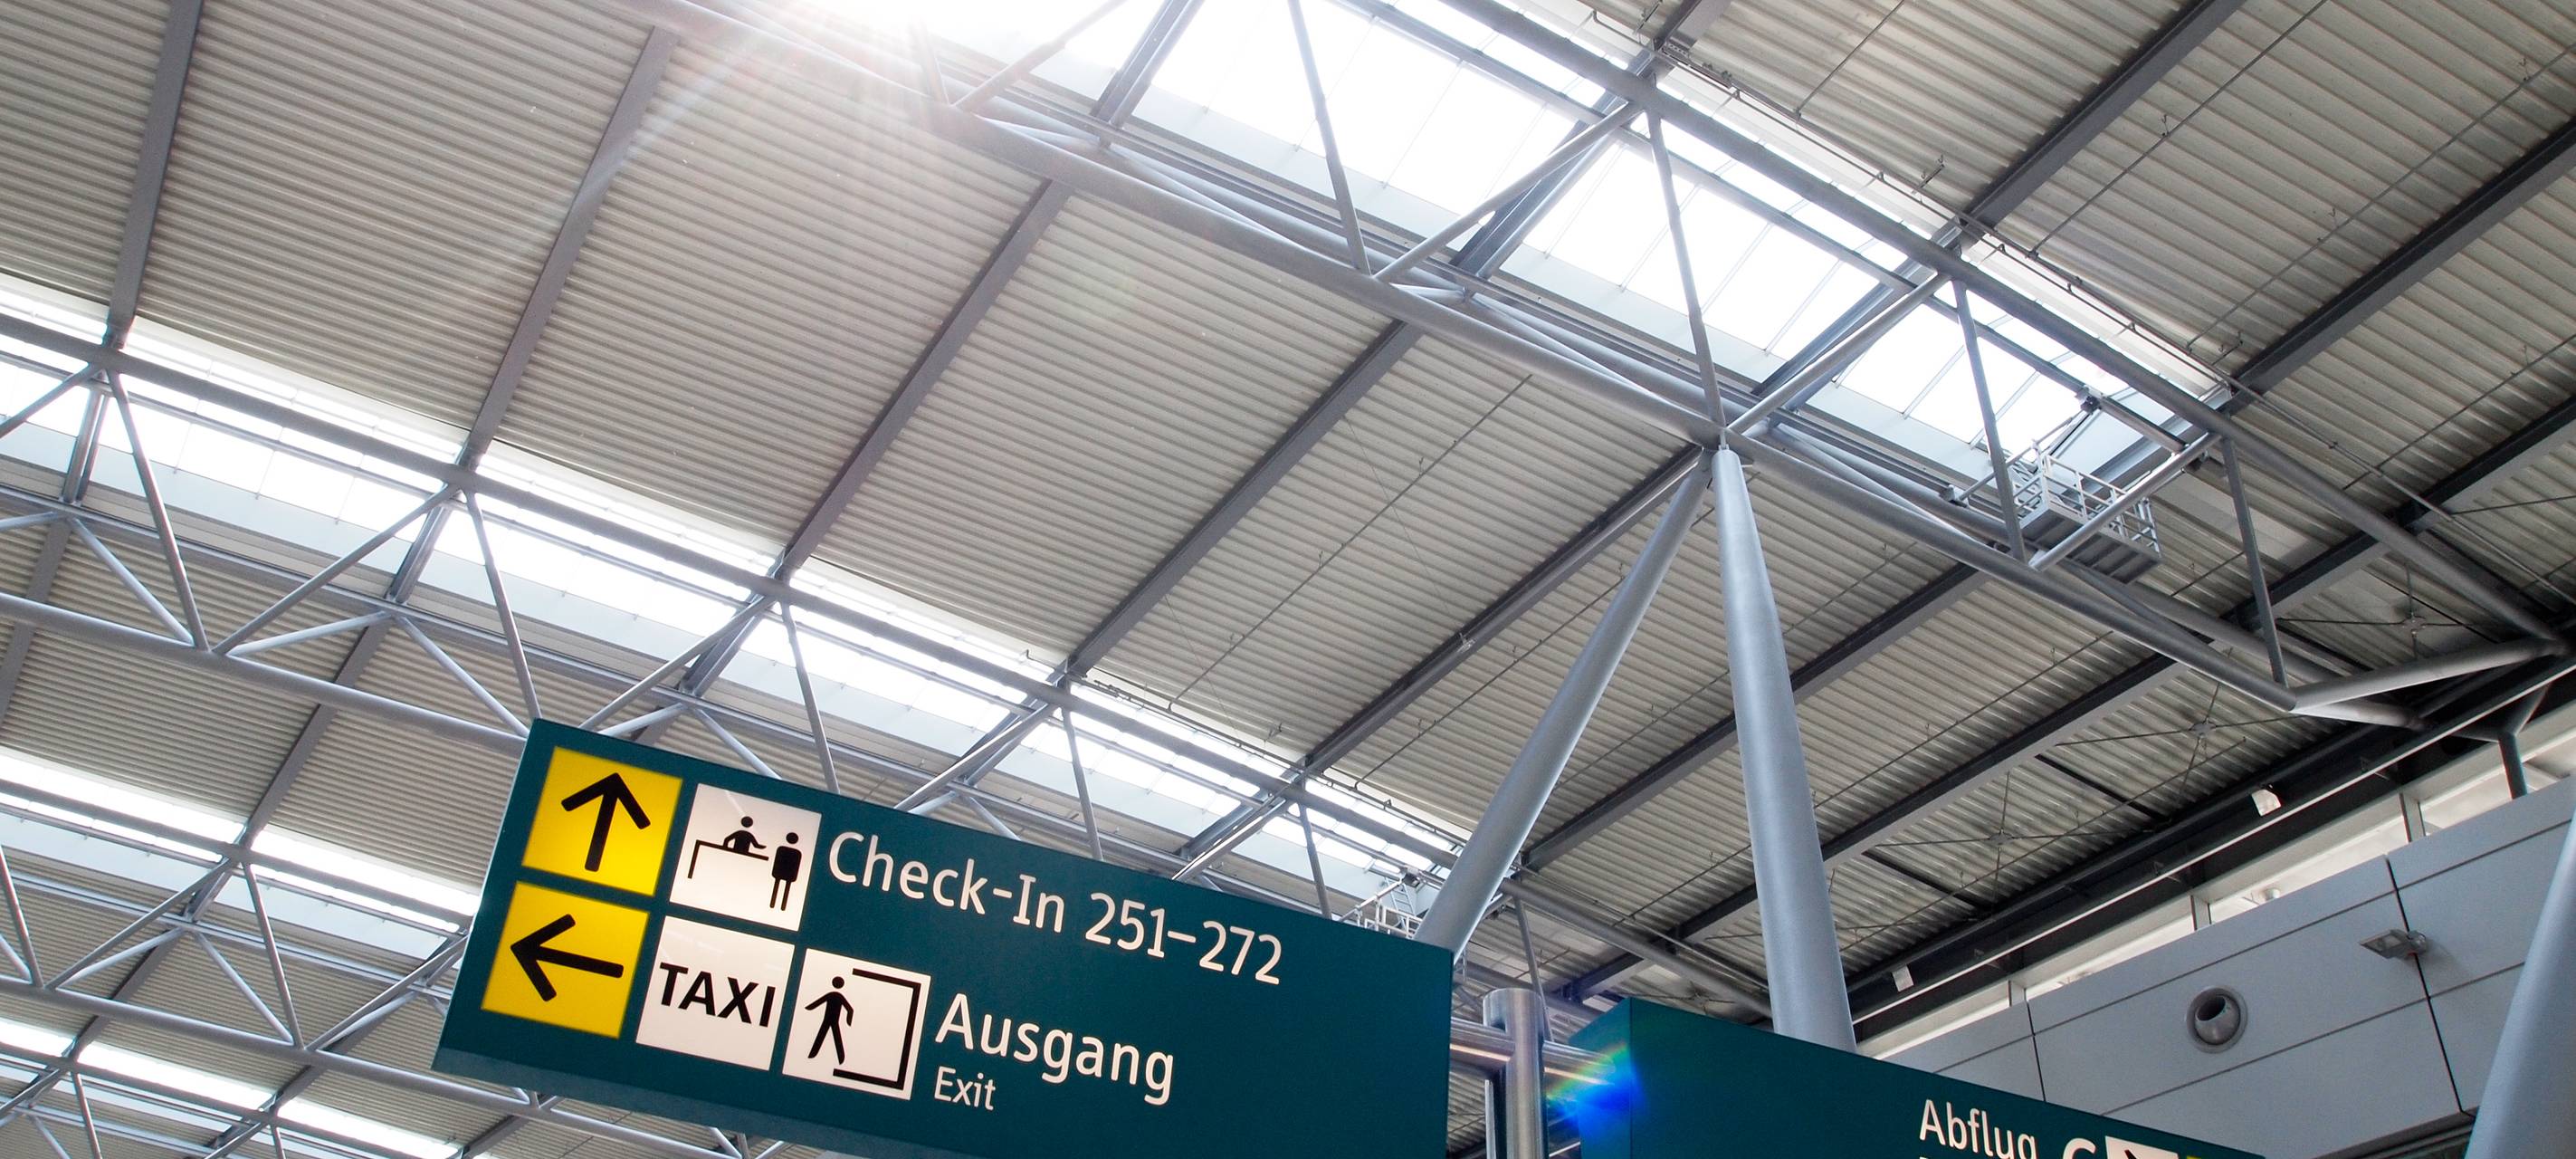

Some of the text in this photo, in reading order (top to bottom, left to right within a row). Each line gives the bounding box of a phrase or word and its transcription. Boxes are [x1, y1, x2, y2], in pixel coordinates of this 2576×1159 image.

[828, 830, 1065, 934] Check-In
[658, 961, 777, 1029] TAXI
[933, 1065, 997, 1112] Exit
[934, 991, 1175, 1106] Ausgang
